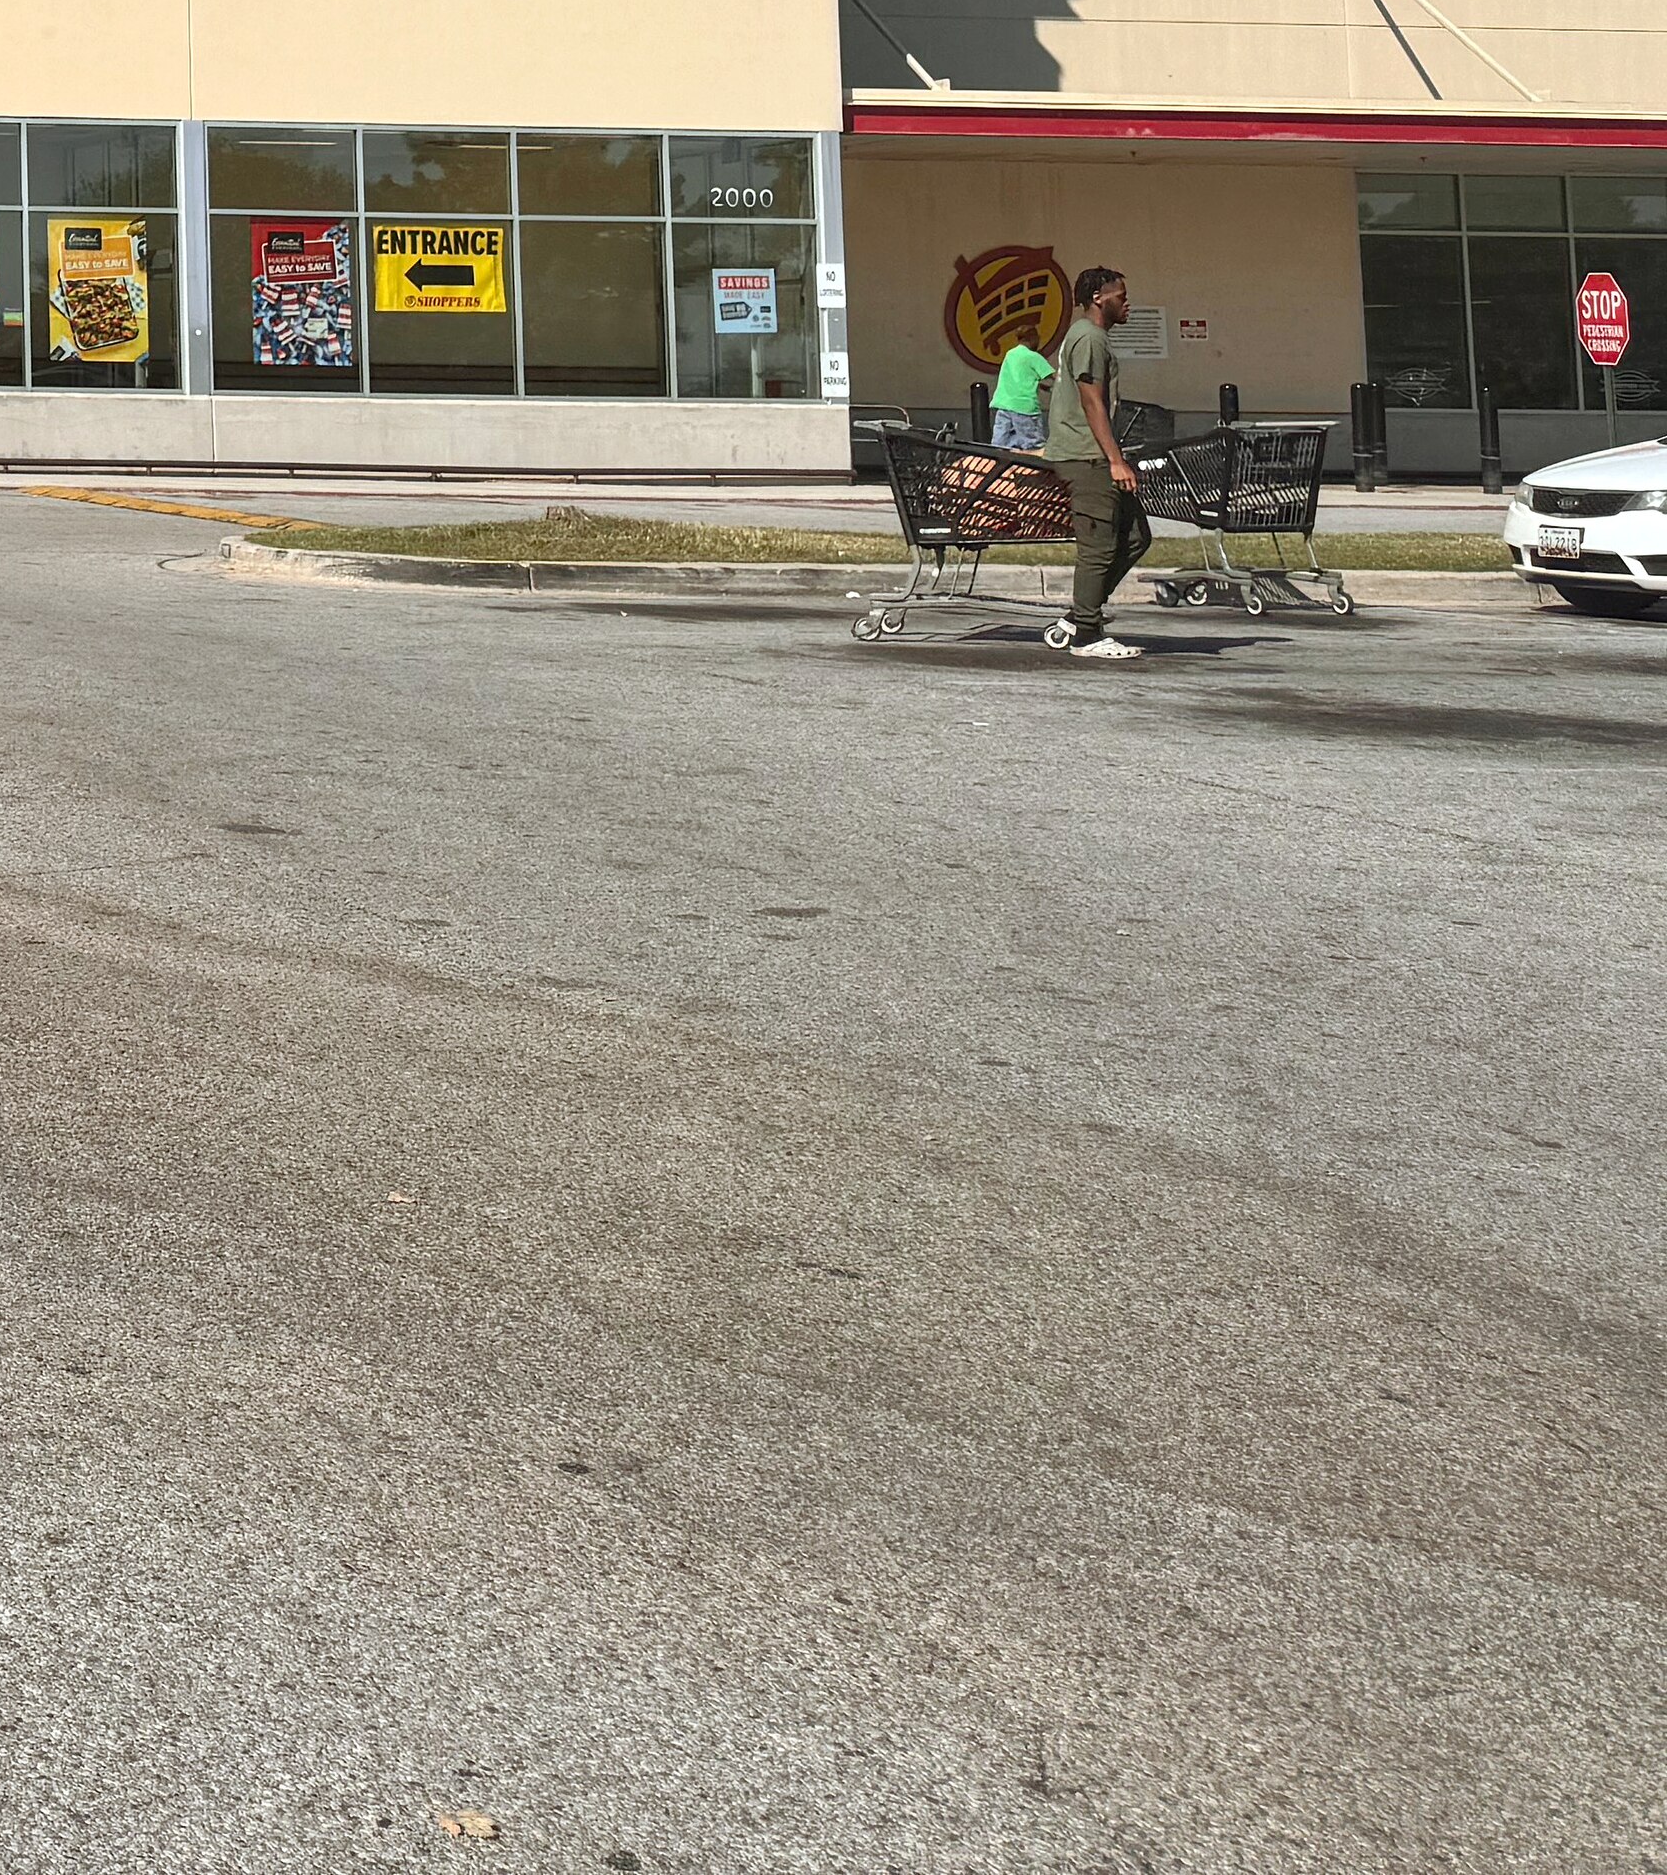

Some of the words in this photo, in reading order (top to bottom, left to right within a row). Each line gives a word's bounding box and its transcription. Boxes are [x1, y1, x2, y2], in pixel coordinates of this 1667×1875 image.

[710, 187, 774, 208] 2000
[377, 229, 499, 255] ENTRANCE
[66, 261, 91, 270] EASY
[92, 260, 103, 268] to
[104, 258, 129, 267] SAVE
[268, 256, 289, 264] MAKE
[291, 254, 330, 263] EVERYDAY
[268, 265, 293, 274] EASY
[295, 264, 306, 272] to
[307, 262, 332, 271] SAVE
[720, 277, 769, 288] SAVINGS
[826, 271, 836, 282] NO
[416, 296, 481, 308] SHOPPERS
[1581, 290, 1621, 320] STOP
[829, 360, 840, 371] NO
